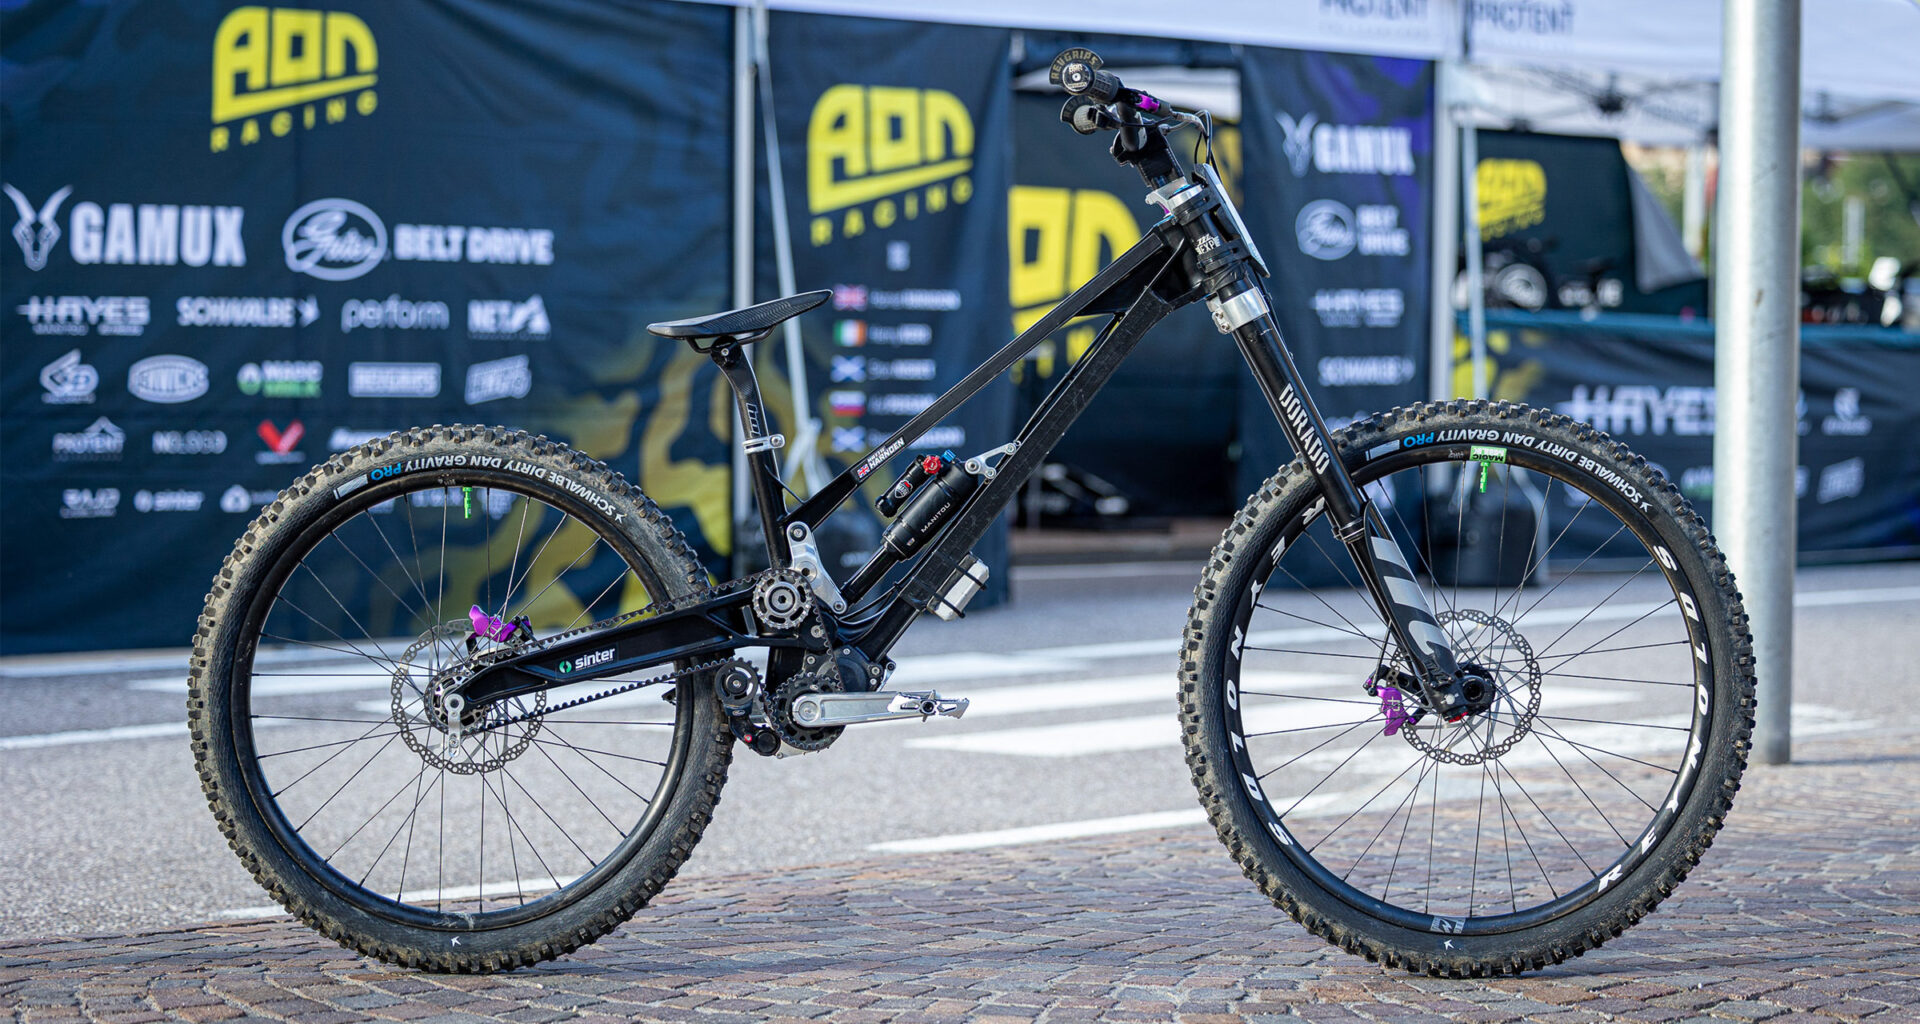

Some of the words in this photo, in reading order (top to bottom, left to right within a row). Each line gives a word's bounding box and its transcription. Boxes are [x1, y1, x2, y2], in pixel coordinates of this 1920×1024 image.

[212, 6, 378, 108] AON
[211, 90, 378, 152] RACING
[808, 85, 975, 195] AON
[811, 177, 973, 247] RACING
[70, 202, 246, 266] GAMUX
[394, 223, 465, 262] BELT
[467, 226, 554, 265] DRIVE
[16, 296, 150, 325] HAYES
[177, 297, 297, 327] SCHWALBE
[341, 294, 449, 333] perform
[1279, 383, 1331, 475] DORADO
[1403, 432, 1435, 448] PRO
[1437, 429, 1499, 442] GRAVITY
[1502, 432, 1535, 447] DAN
[405, 455, 467, 472] GRAVITY
[470, 456, 503, 468] DAN
[869, 436, 905, 470] HARNDEN
[1535, 440, 1578, 463] DIRTY
[371, 462, 402, 481] PRO
[504, 459, 547, 479] DIRTY
[1578, 455, 1643, 503] SCHWALBE
[548, 471, 616, 517] SCHWALBE
[921, 501, 951, 533] MANITOU
[575, 647, 616, 669] sinter
